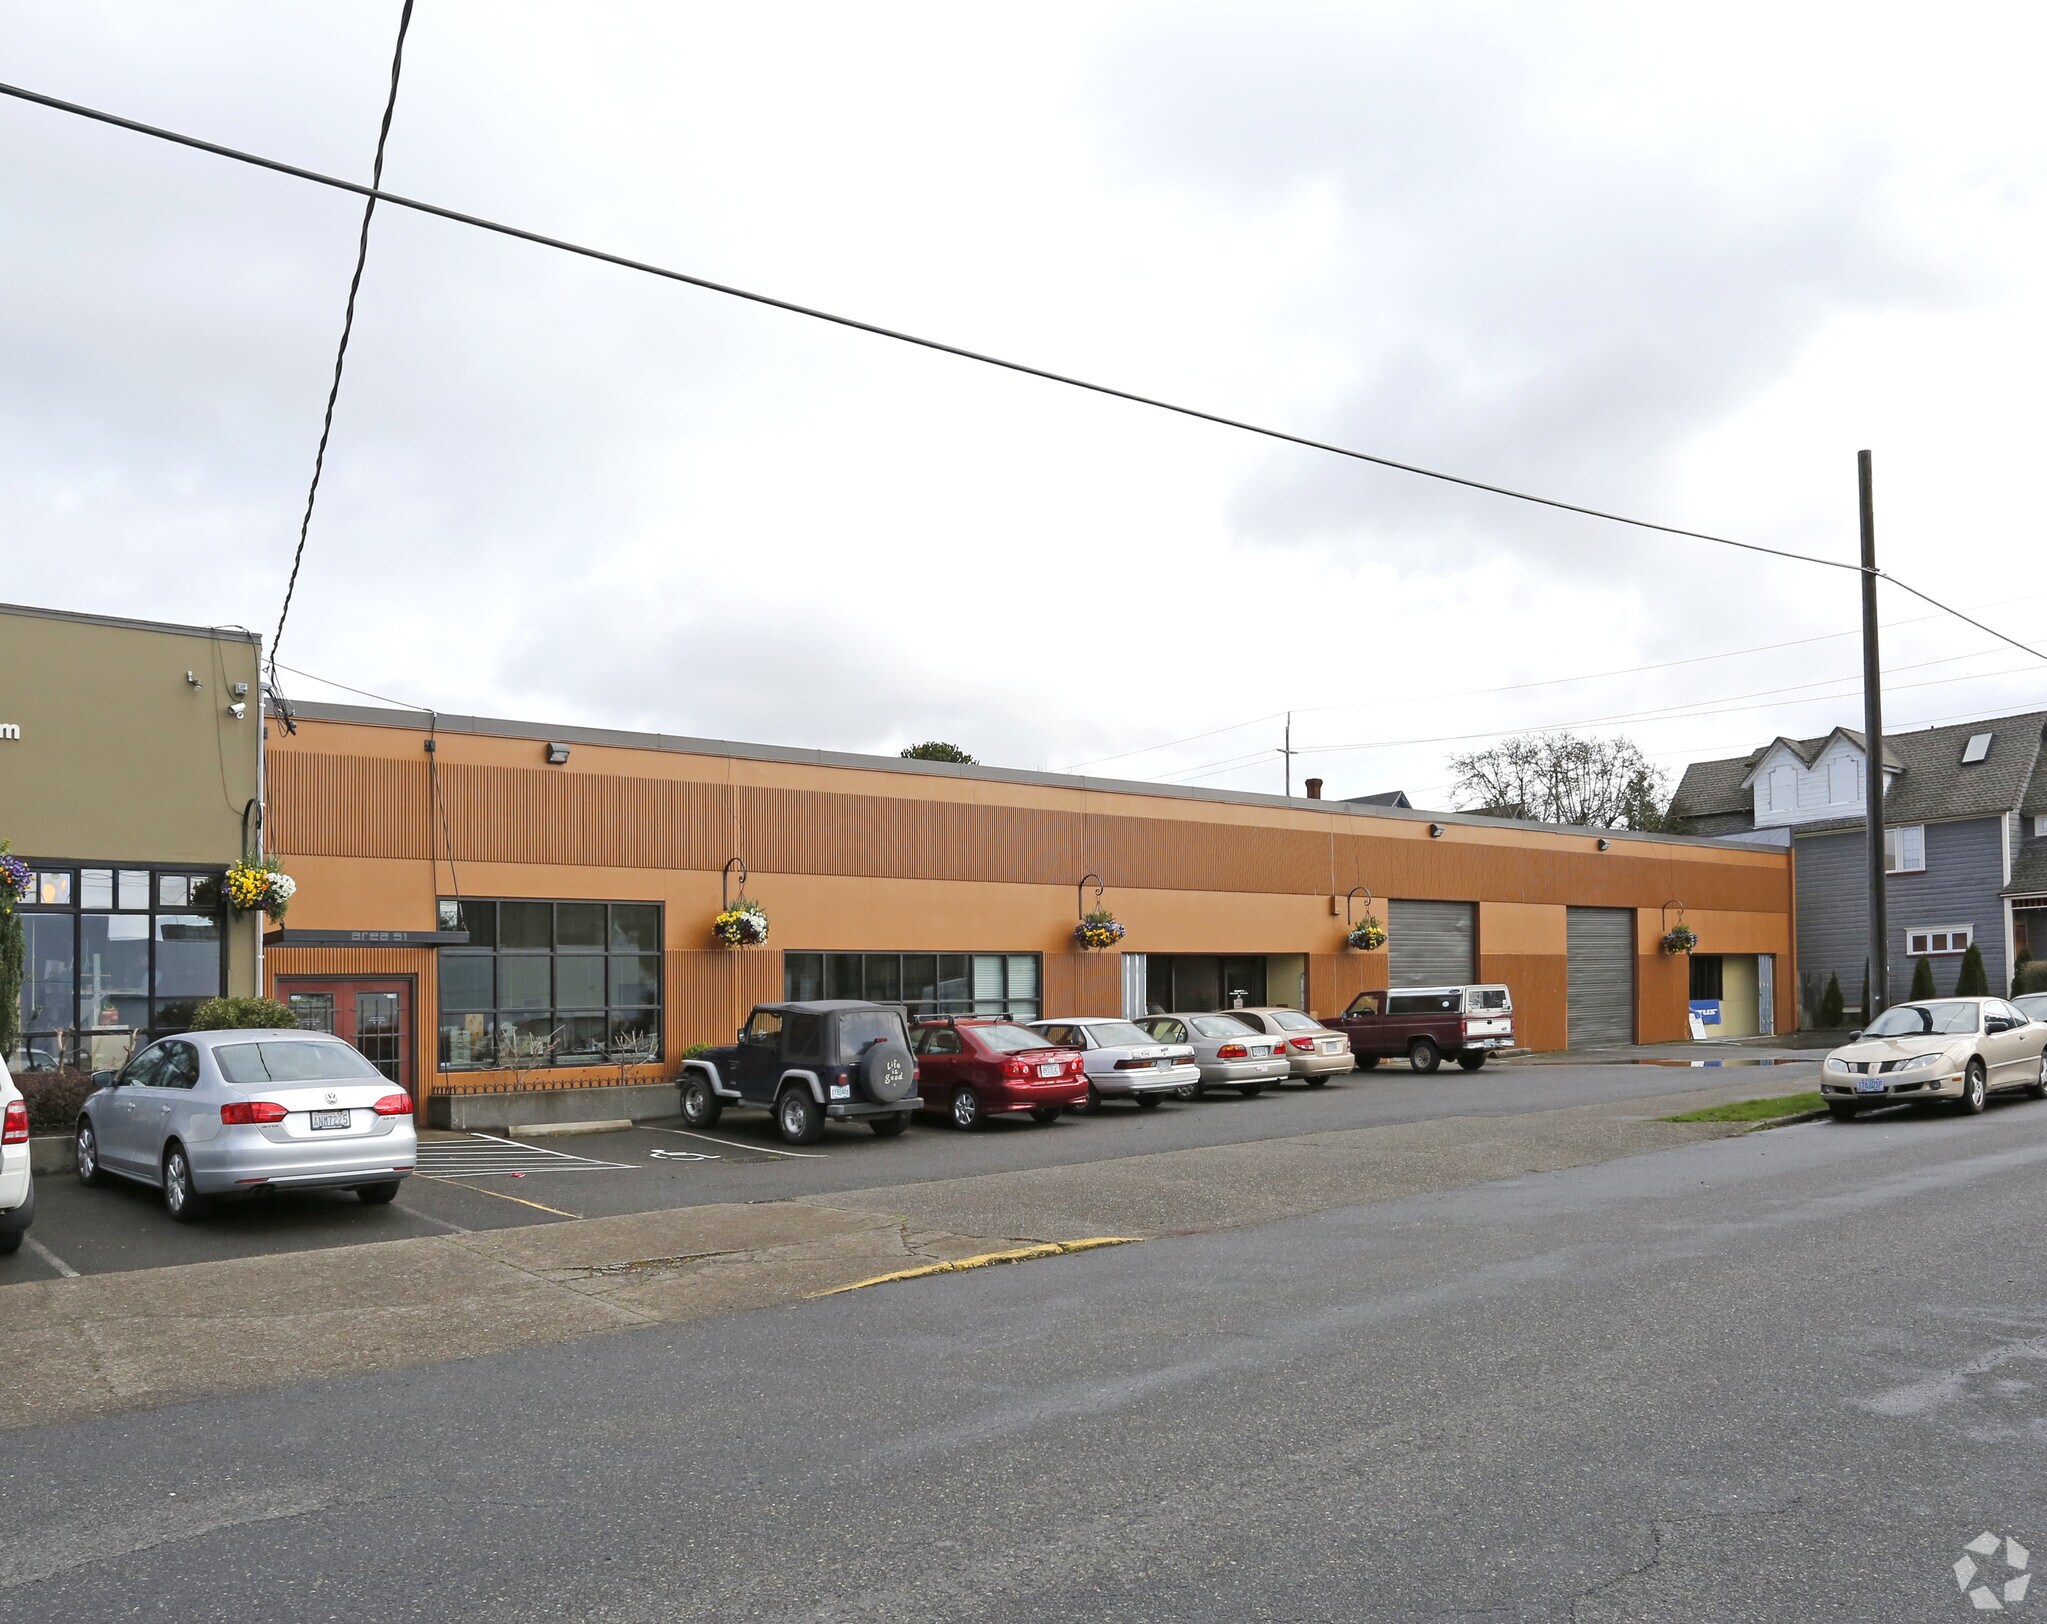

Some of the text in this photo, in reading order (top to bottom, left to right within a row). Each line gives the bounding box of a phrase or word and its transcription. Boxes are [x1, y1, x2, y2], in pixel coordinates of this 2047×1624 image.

[351, 931, 407, 941] area 51
[886, 1059, 901, 1070] Life
[884, 1071, 904, 1085] good
